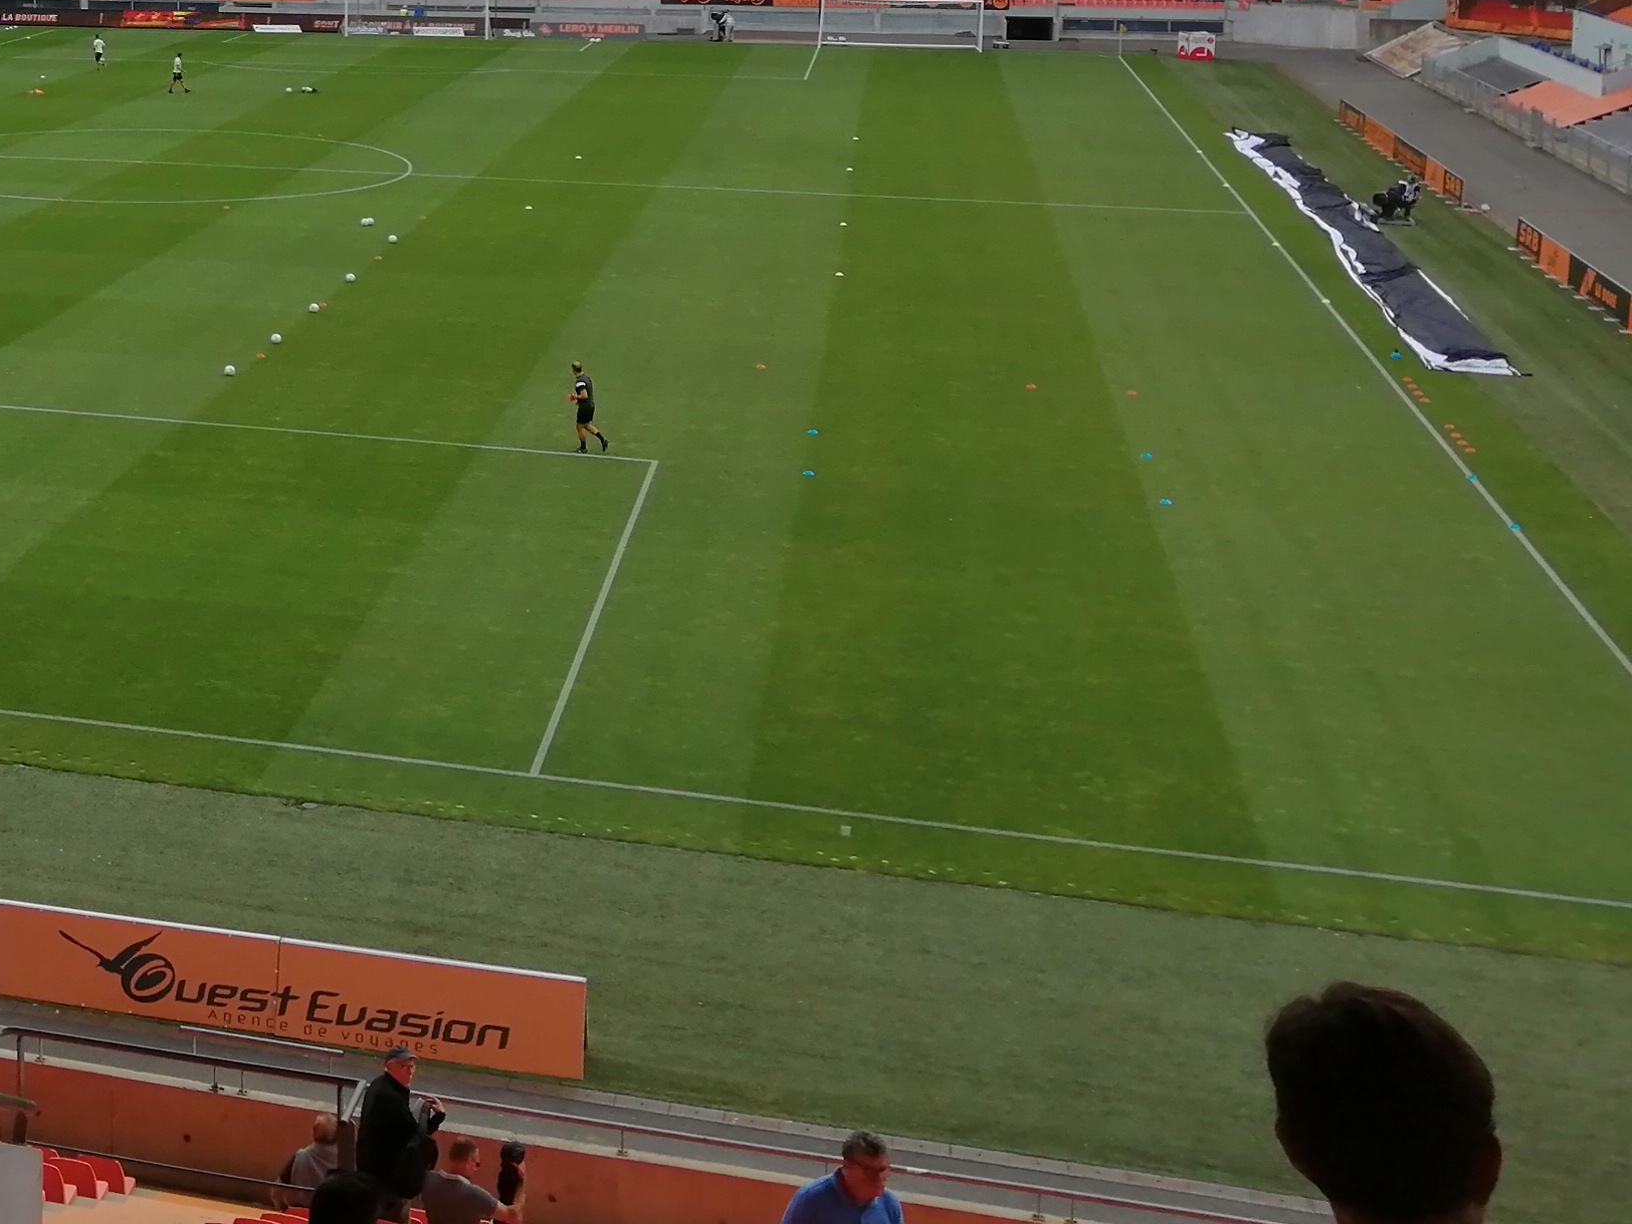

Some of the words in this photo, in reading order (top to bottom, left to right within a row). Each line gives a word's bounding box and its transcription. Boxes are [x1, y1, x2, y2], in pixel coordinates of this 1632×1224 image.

[2, 12, 13, 22] LA
[15, 12, 58, 22] BOUTIQUE
[313, 20, 340, 28] SONT
[559, 24, 596, 33] LEROY
[597, 25, 639, 34] MERLIN
[1519, 223, 1540, 252] SRB
[121, 953, 300, 1017] Ouest
[305, 989, 510, 1050] Evasion
[208, 1009, 289, 1033] Agence
[303, 1023, 328, 1039] de
[341, 1029, 439, 1055] voyages
